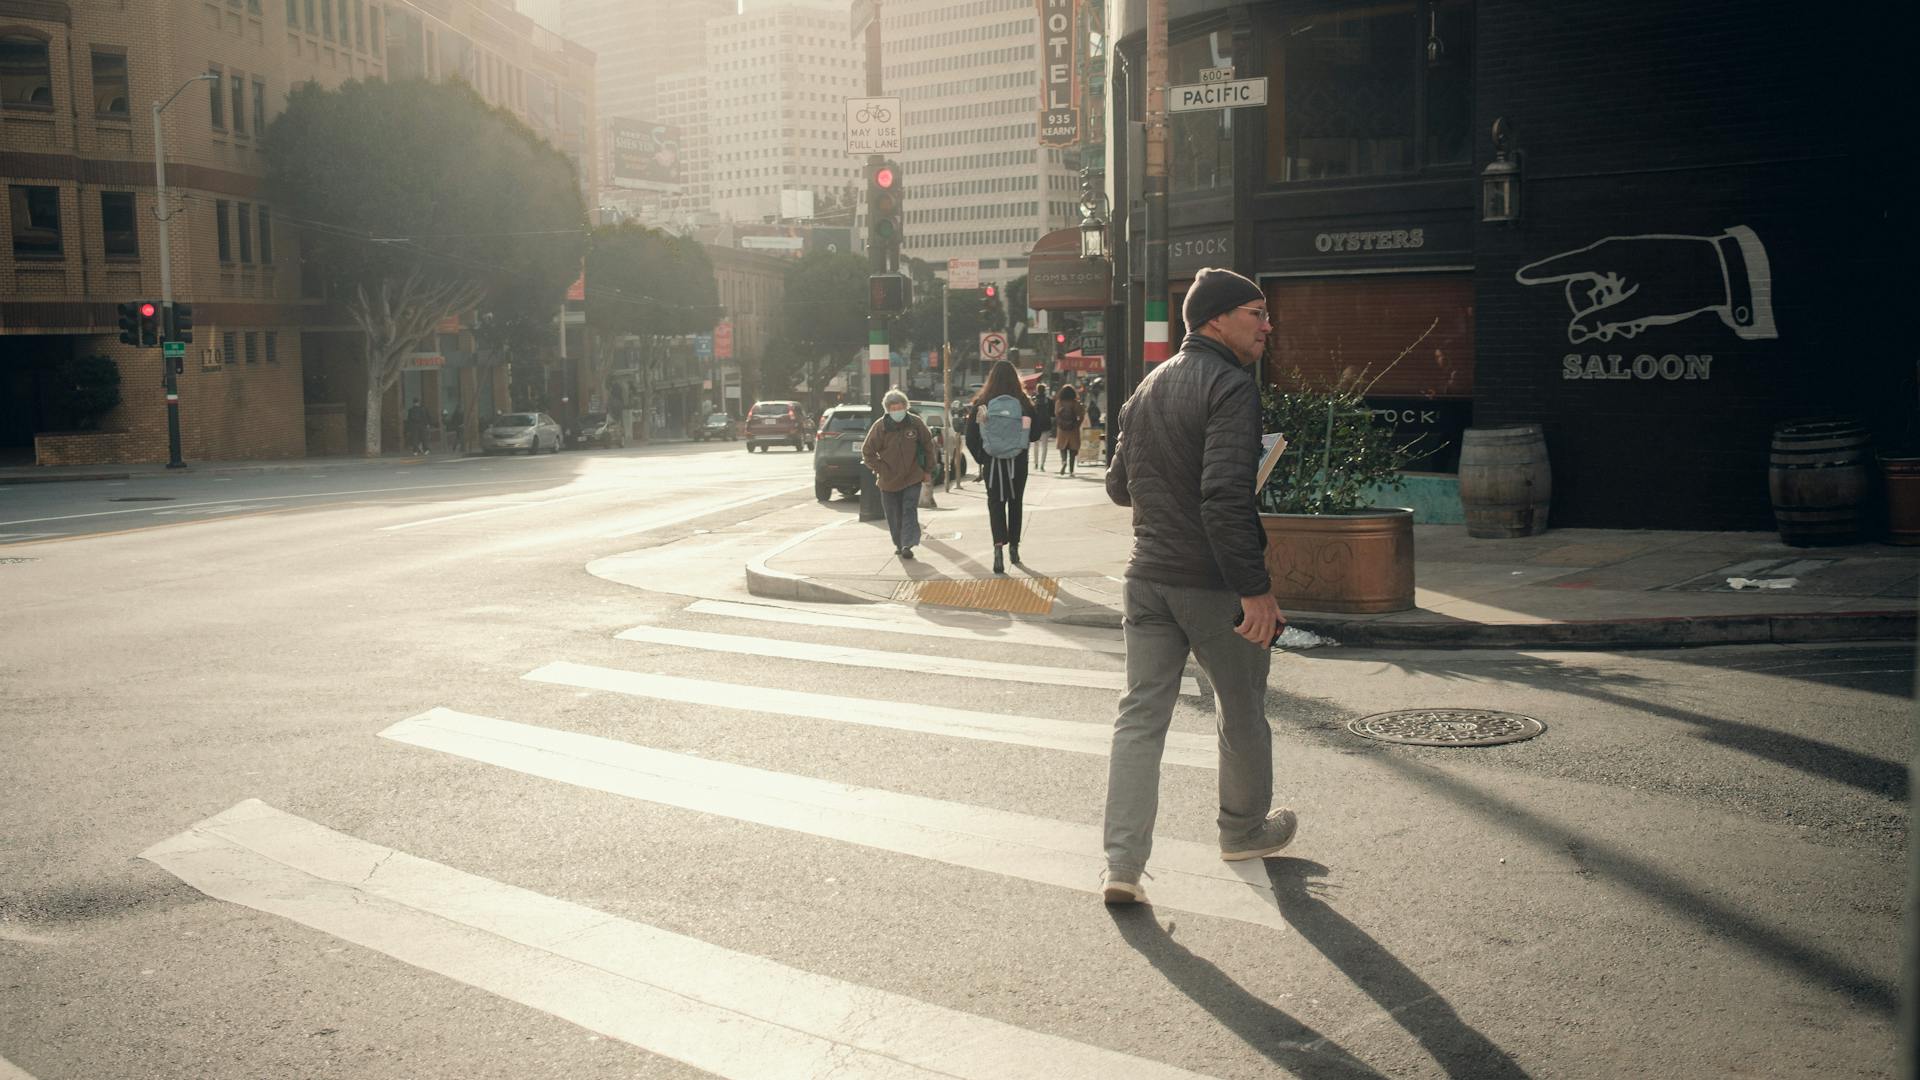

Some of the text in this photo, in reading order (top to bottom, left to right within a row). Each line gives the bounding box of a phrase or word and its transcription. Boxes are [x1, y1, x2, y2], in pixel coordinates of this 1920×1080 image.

[1203, 70, 1222, 81] 600
[1183, 86, 1250, 106] PACIFIC
[1049, 114, 1071, 125] 935
[851, 128, 896, 137] MAY USE
[1042, 127, 1076, 136] KEARNY
[850, 140, 899, 149] FULL LANE
[1315, 228, 1424, 252] OYSTERS
[1035, 273, 1103, 281] COMSTOCK
[1562, 353, 1713, 380] SALOON
[1384, 409, 1435, 423] OCK
